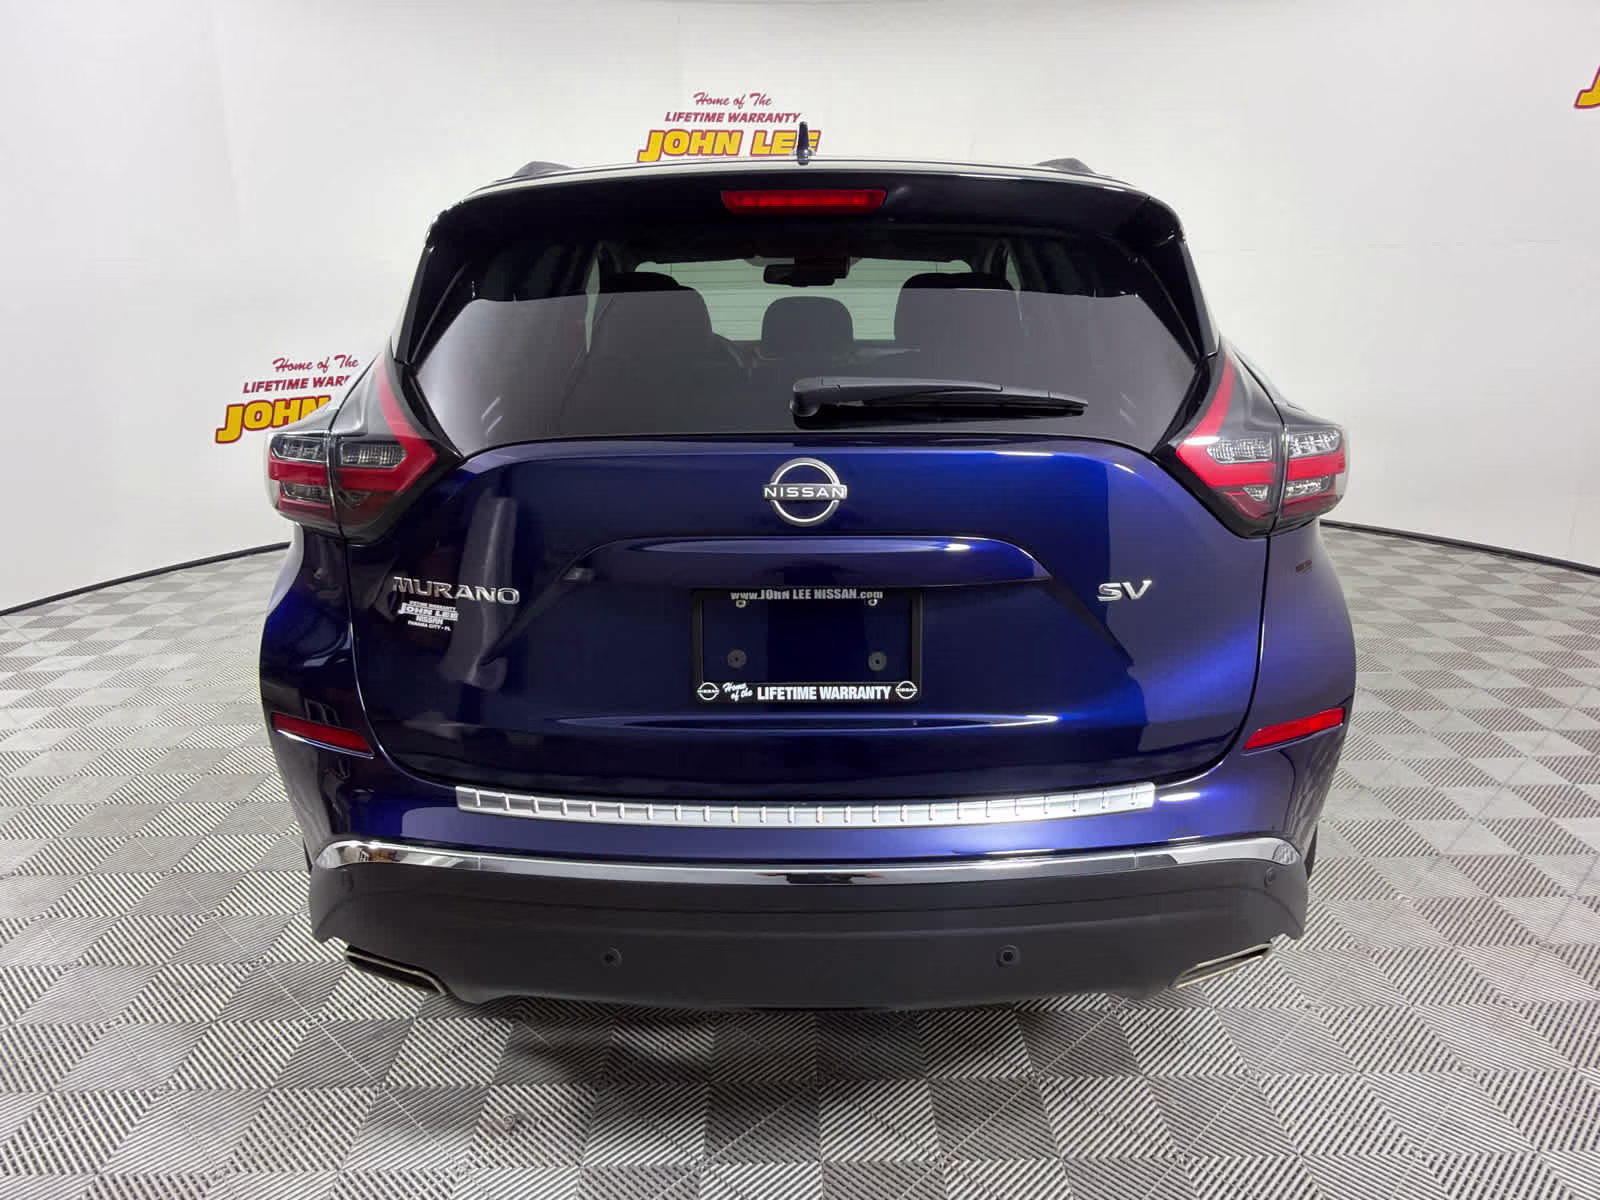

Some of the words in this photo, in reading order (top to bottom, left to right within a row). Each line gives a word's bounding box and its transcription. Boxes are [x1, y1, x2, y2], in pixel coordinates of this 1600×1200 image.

[693, 92, 729, 106] Home
[733, 94, 746, 109] of
[750, 93, 772, 106] The
[665, 112, 724, 123] LIFETIME
[728, 112, 801, 124] WARRANTY
[637, 129, 744, 163] JOHN
[272, 357, 313, 372] Home
[317, 357, 330, 374] of
[334, 355, 359, 368] The
[243, 378, 309, 393] LIFETIME
[764, 487, 844, 498] NISSAN
[392, 576, 520, 605] MURANO
[793, 589, 812, 600] LEE
[1097, 580, 1152, 602] SV
[397, 602, 433, 616] JOHN
[757, 686, 817, 700] LIFETIME
[819, 686, 892, 700] WARRANTY
